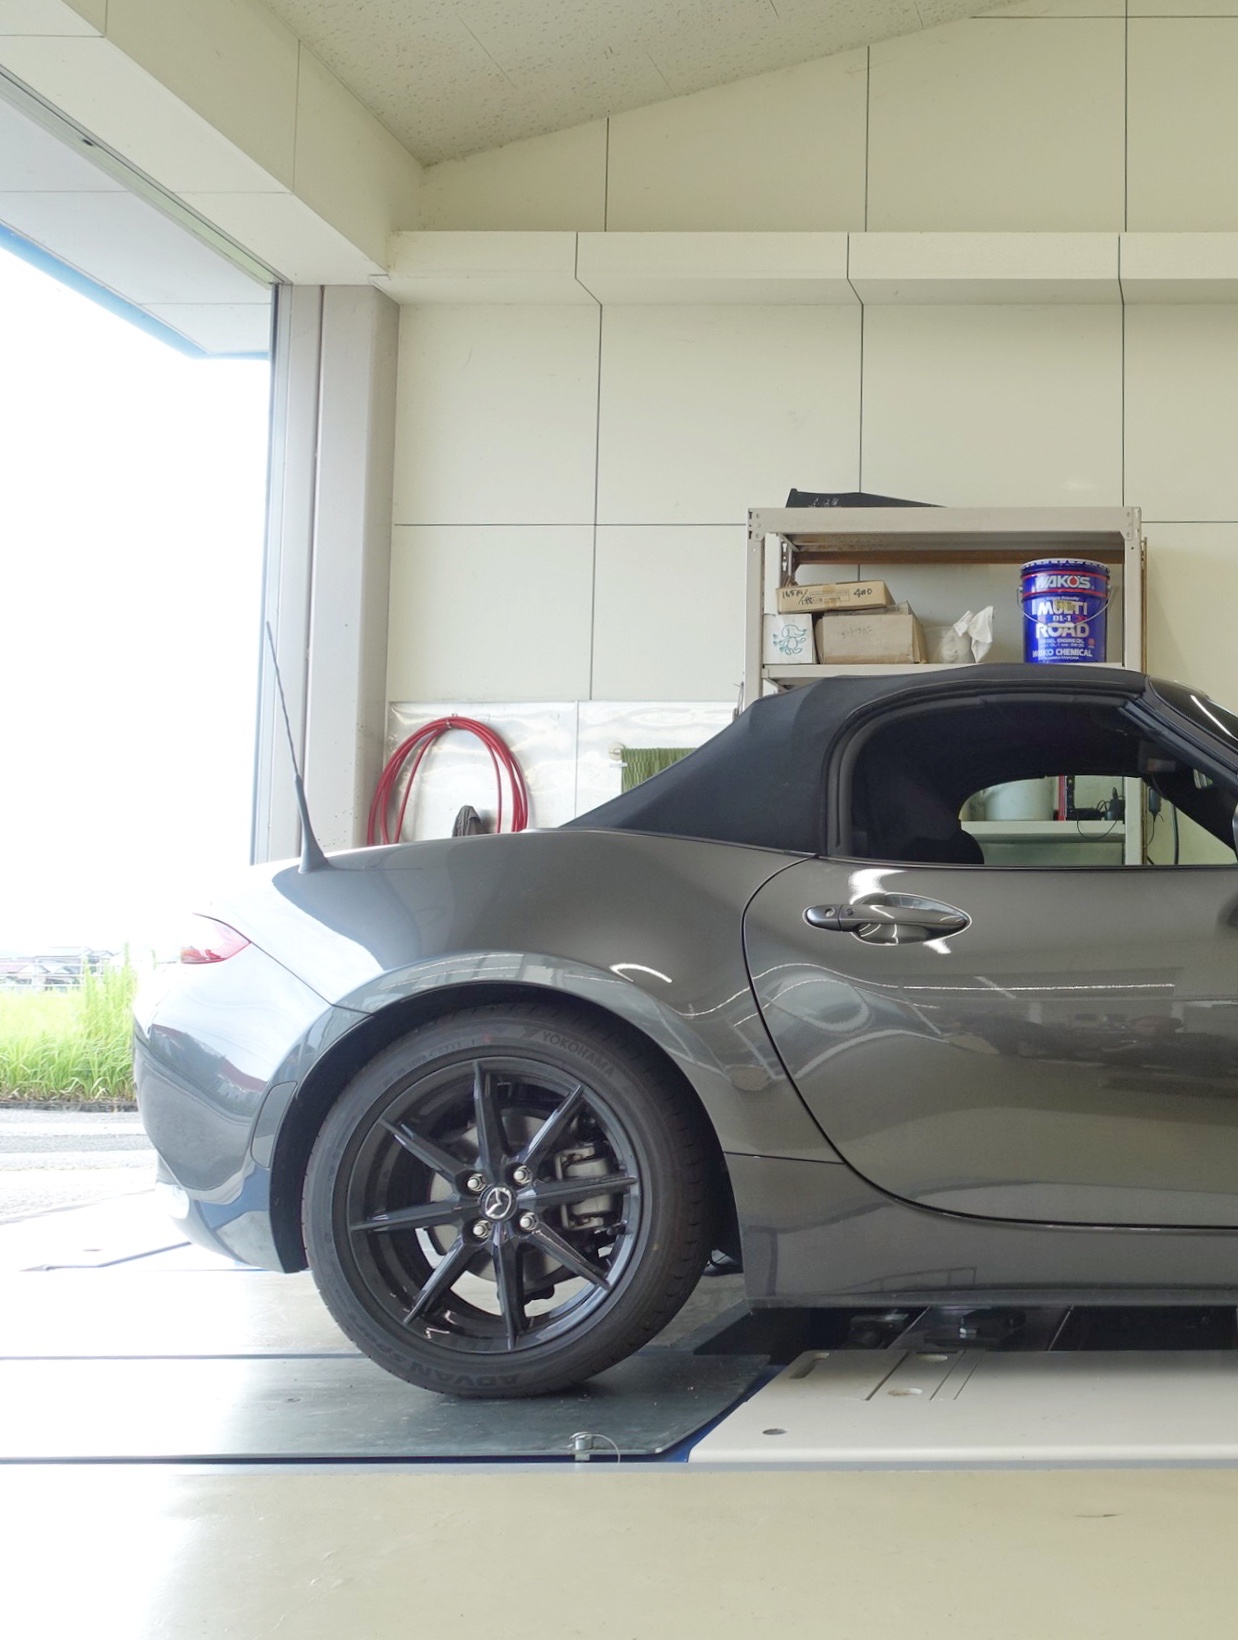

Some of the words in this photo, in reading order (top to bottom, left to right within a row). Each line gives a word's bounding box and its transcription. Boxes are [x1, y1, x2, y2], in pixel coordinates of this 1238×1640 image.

[1036, 622, 1090, 638] ROAD
[1056, 648, 1093, 658] CHEMICAL
[540, 1031, 616, 1077] YOKOHAMA
